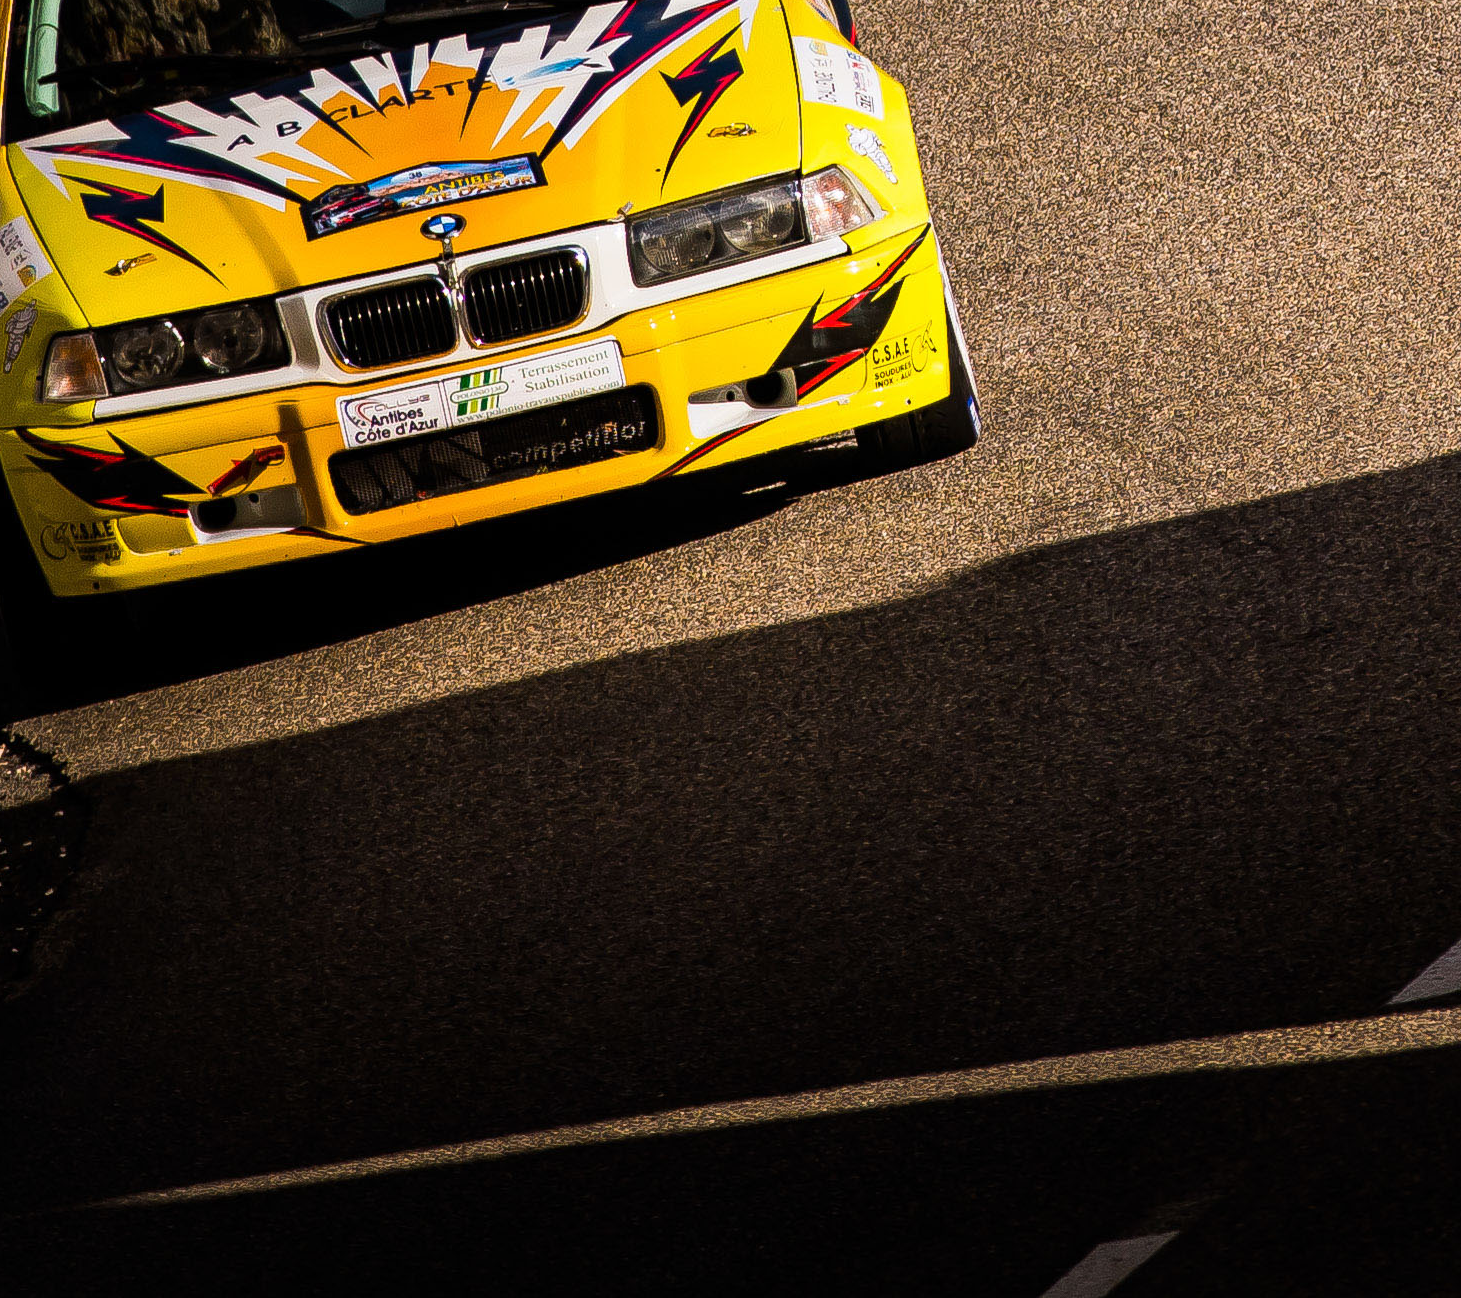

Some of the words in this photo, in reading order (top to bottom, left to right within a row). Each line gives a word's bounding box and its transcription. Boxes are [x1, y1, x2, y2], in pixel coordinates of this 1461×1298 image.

[408, 171, 423, 180] 38
[424, 170, 505, 195] ANTIBES
[518, 349, 609, 379] Terrassement
[524, 365, 610, 393] Stabilisation
[355, 428, 391, 444] Côte
[395, 417, 439, 436] d'Azur
[371, 407, 424, 428] Antibes
